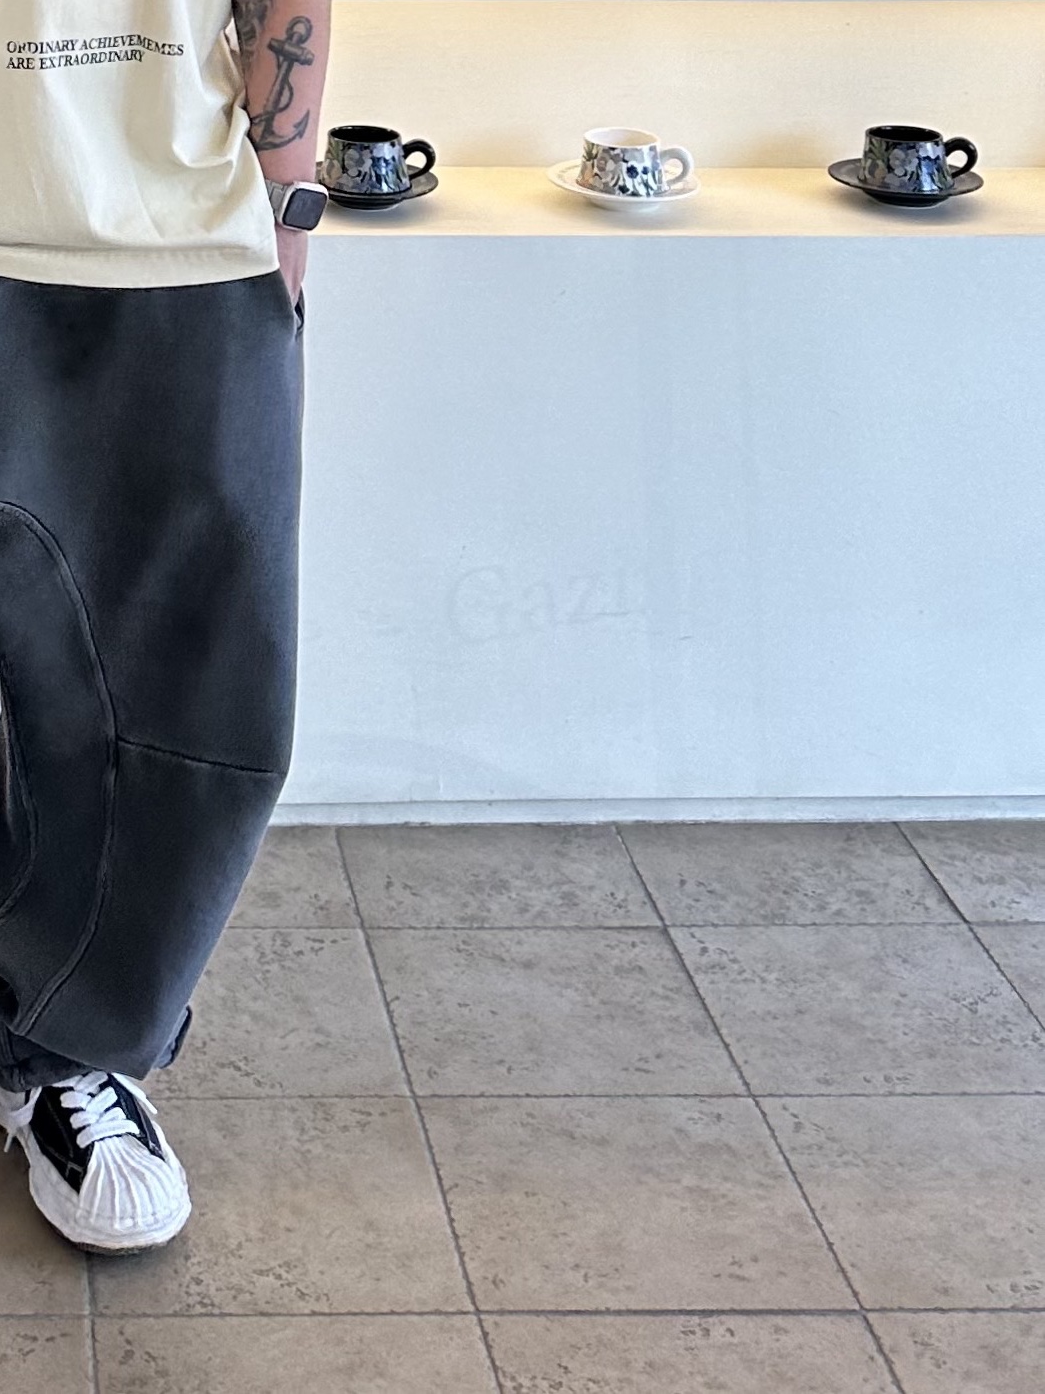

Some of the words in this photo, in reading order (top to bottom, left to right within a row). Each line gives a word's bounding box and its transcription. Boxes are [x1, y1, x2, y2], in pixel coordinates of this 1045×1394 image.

[6, 39, 79, 54] ORDINARY
[6, 56, 36, 70] ARE
[39, 49, 145, 71] EXTRAORDINARY
